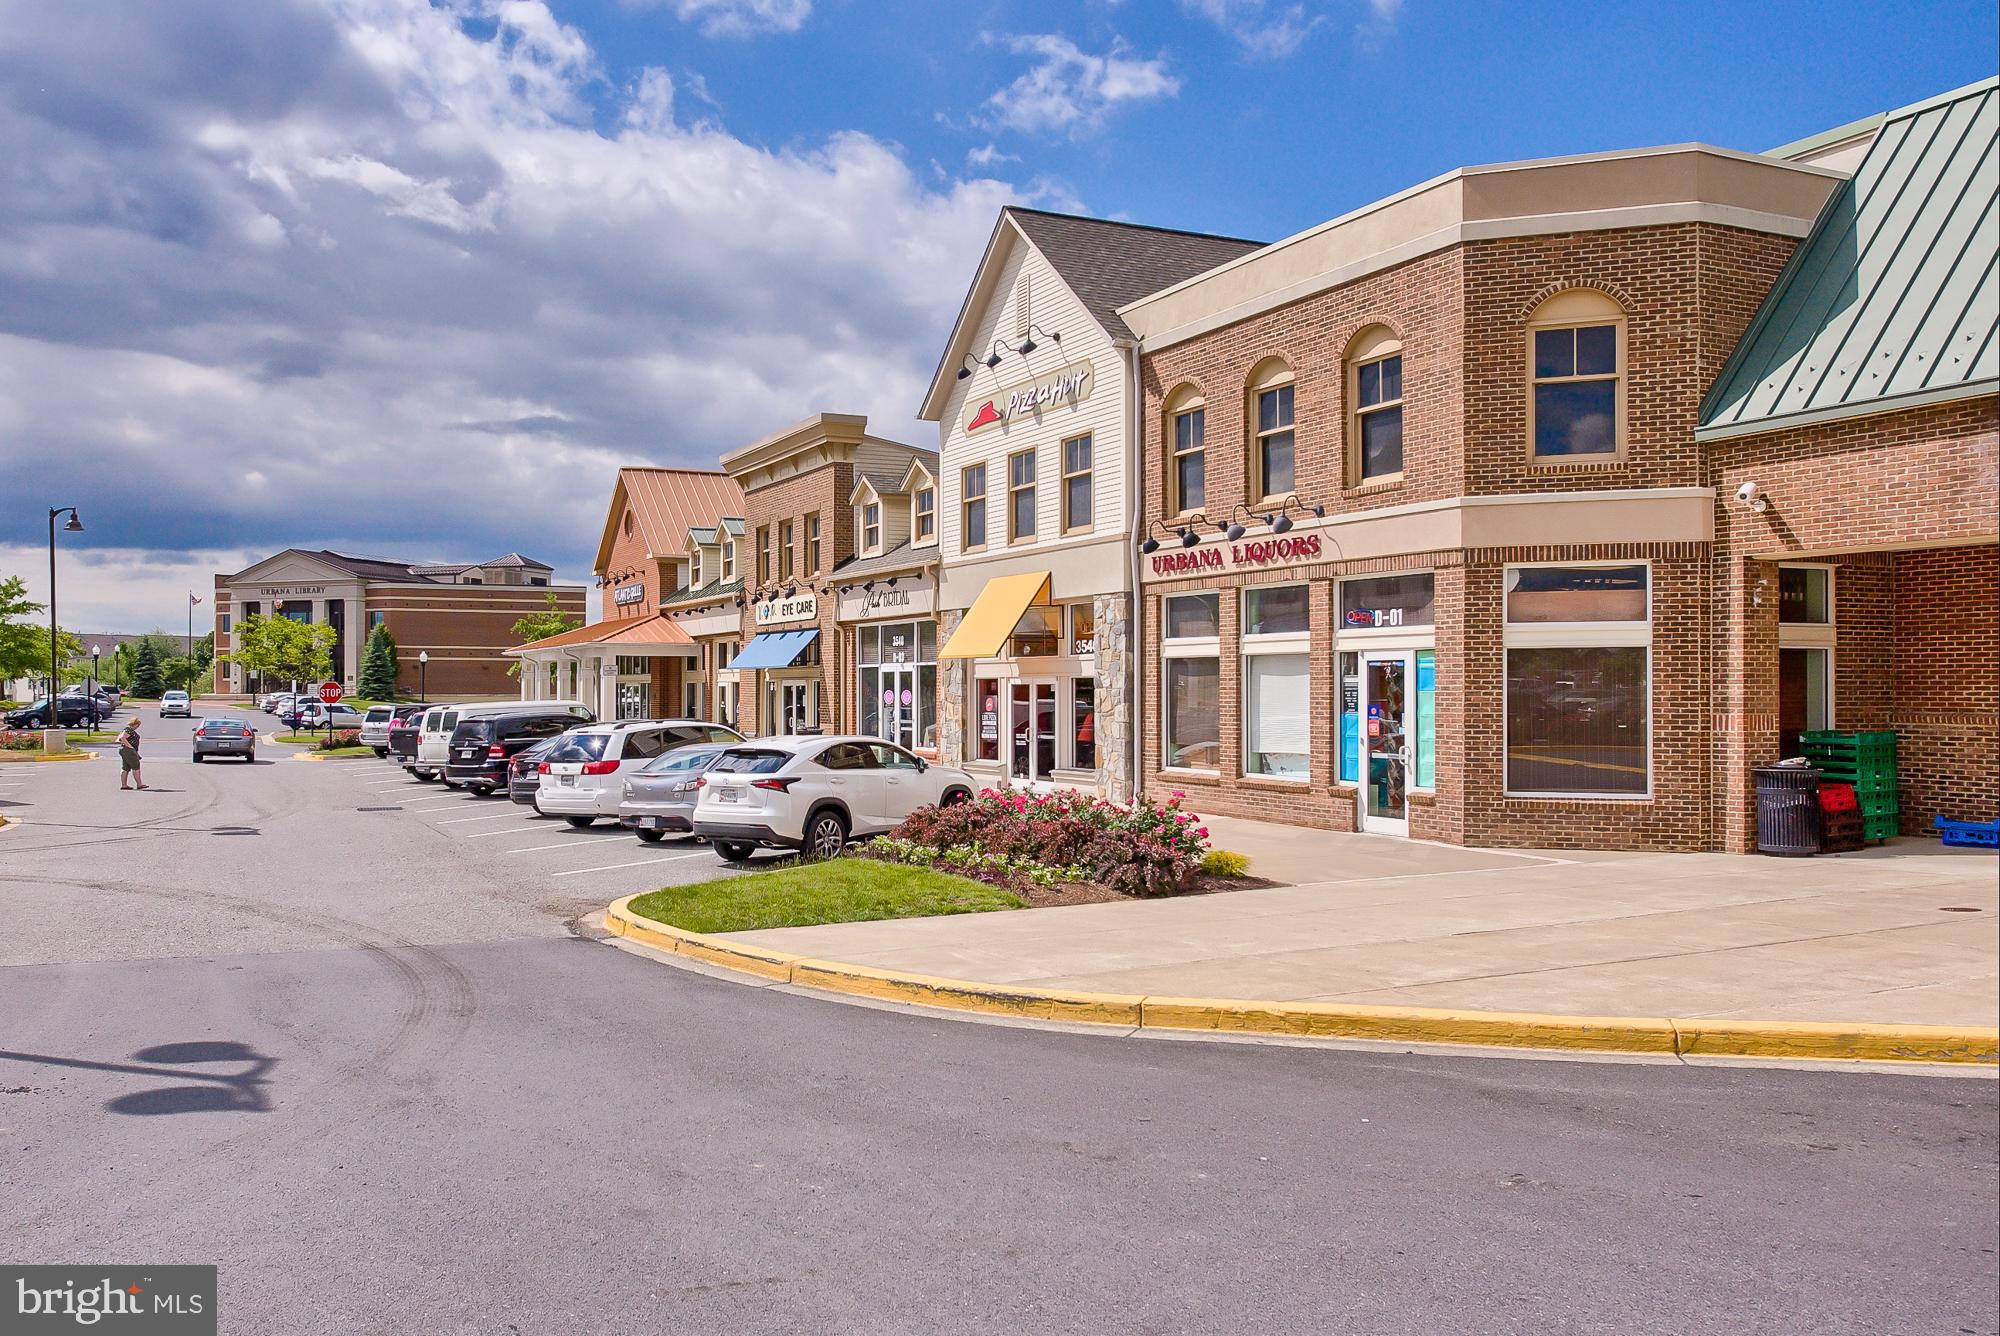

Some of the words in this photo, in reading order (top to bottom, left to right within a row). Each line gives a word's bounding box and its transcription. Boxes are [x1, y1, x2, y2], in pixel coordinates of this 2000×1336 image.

[1152, 548, 1223, 573] URBANA
[1232, 534, 1320, 563] LIQUORS
[295, 586, 326, 594] LIBRARY
[781, 602, 794, 616] EYE
[796, 600, 813, 615] CARE
[1346, 610, 1373, 624] OPEN
[1374, 608, 1403, 627] D-01
[320, 688, 341, 697] STOP
